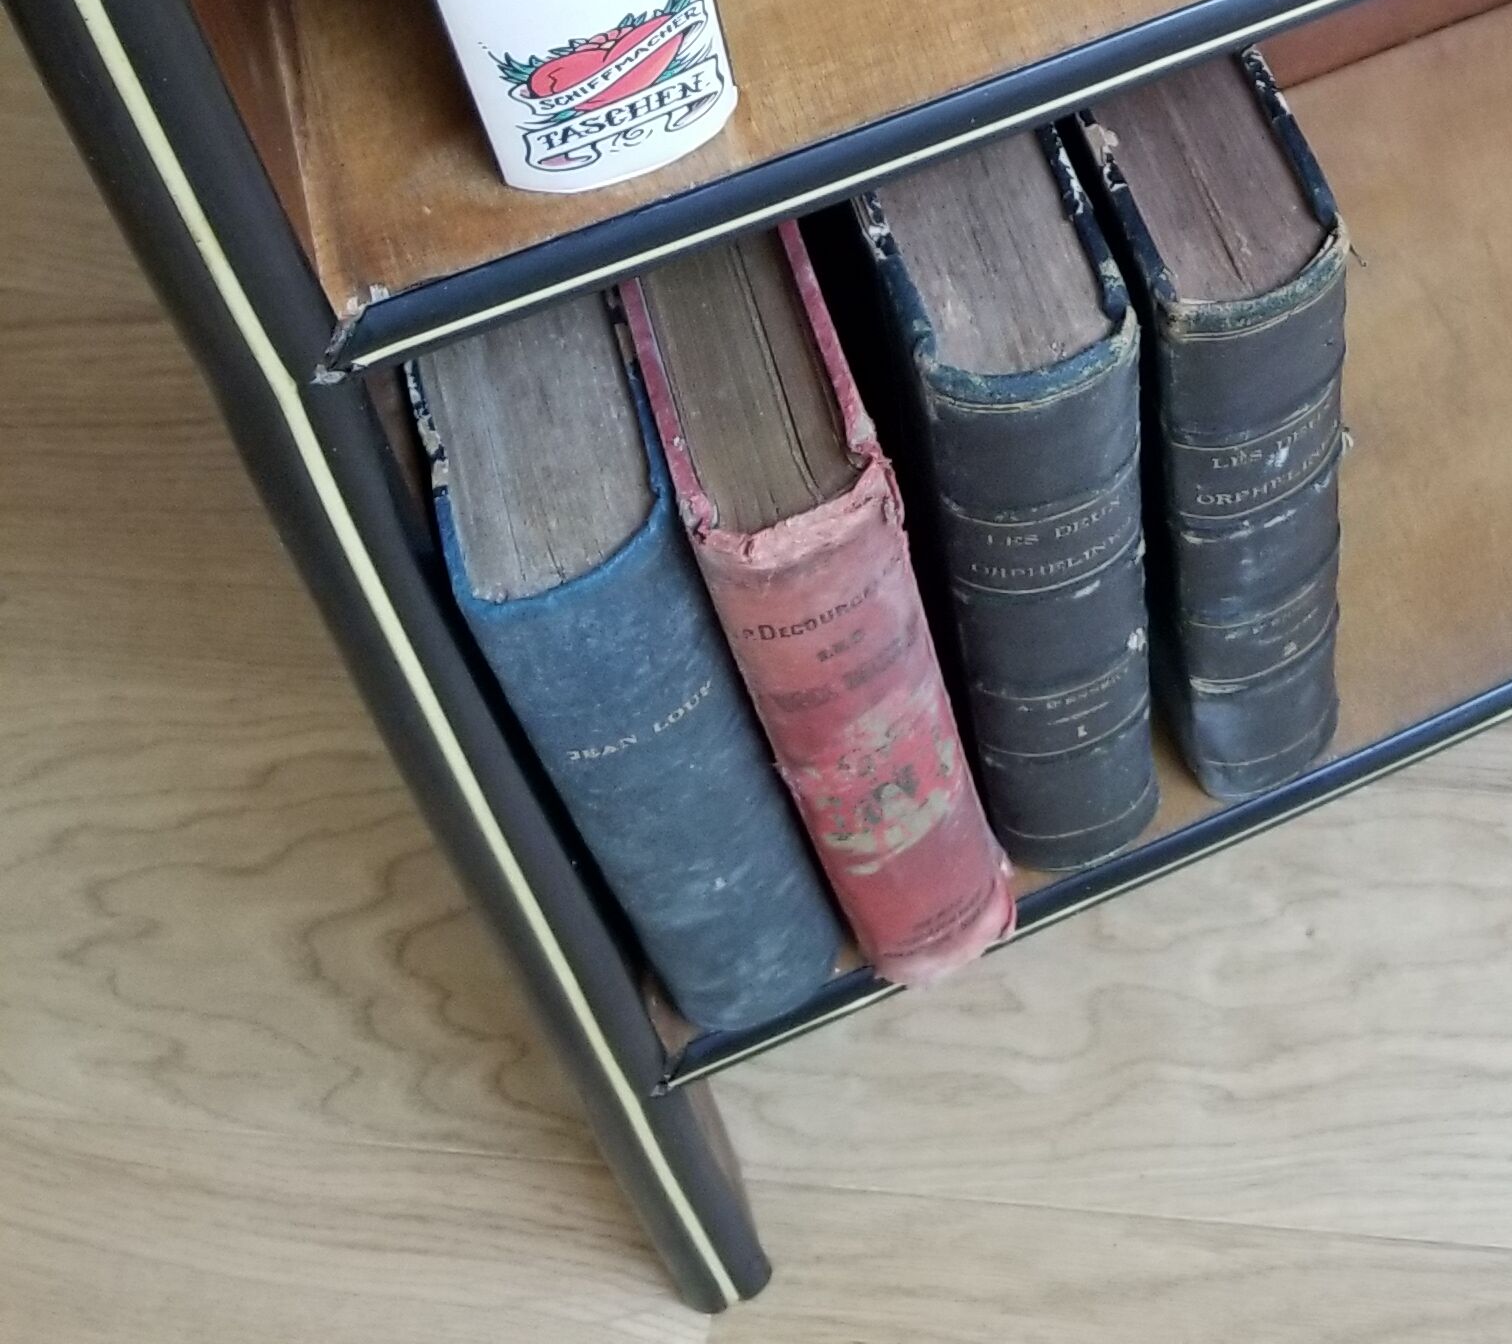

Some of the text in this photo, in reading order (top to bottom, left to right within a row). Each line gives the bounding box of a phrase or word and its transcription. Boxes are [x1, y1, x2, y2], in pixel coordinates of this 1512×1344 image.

[538, 6, 704, 111] SCHIFFMACHER
[537, 70, 705, 151] TASCHEN
[566, 734, 638, 761] JEAN
